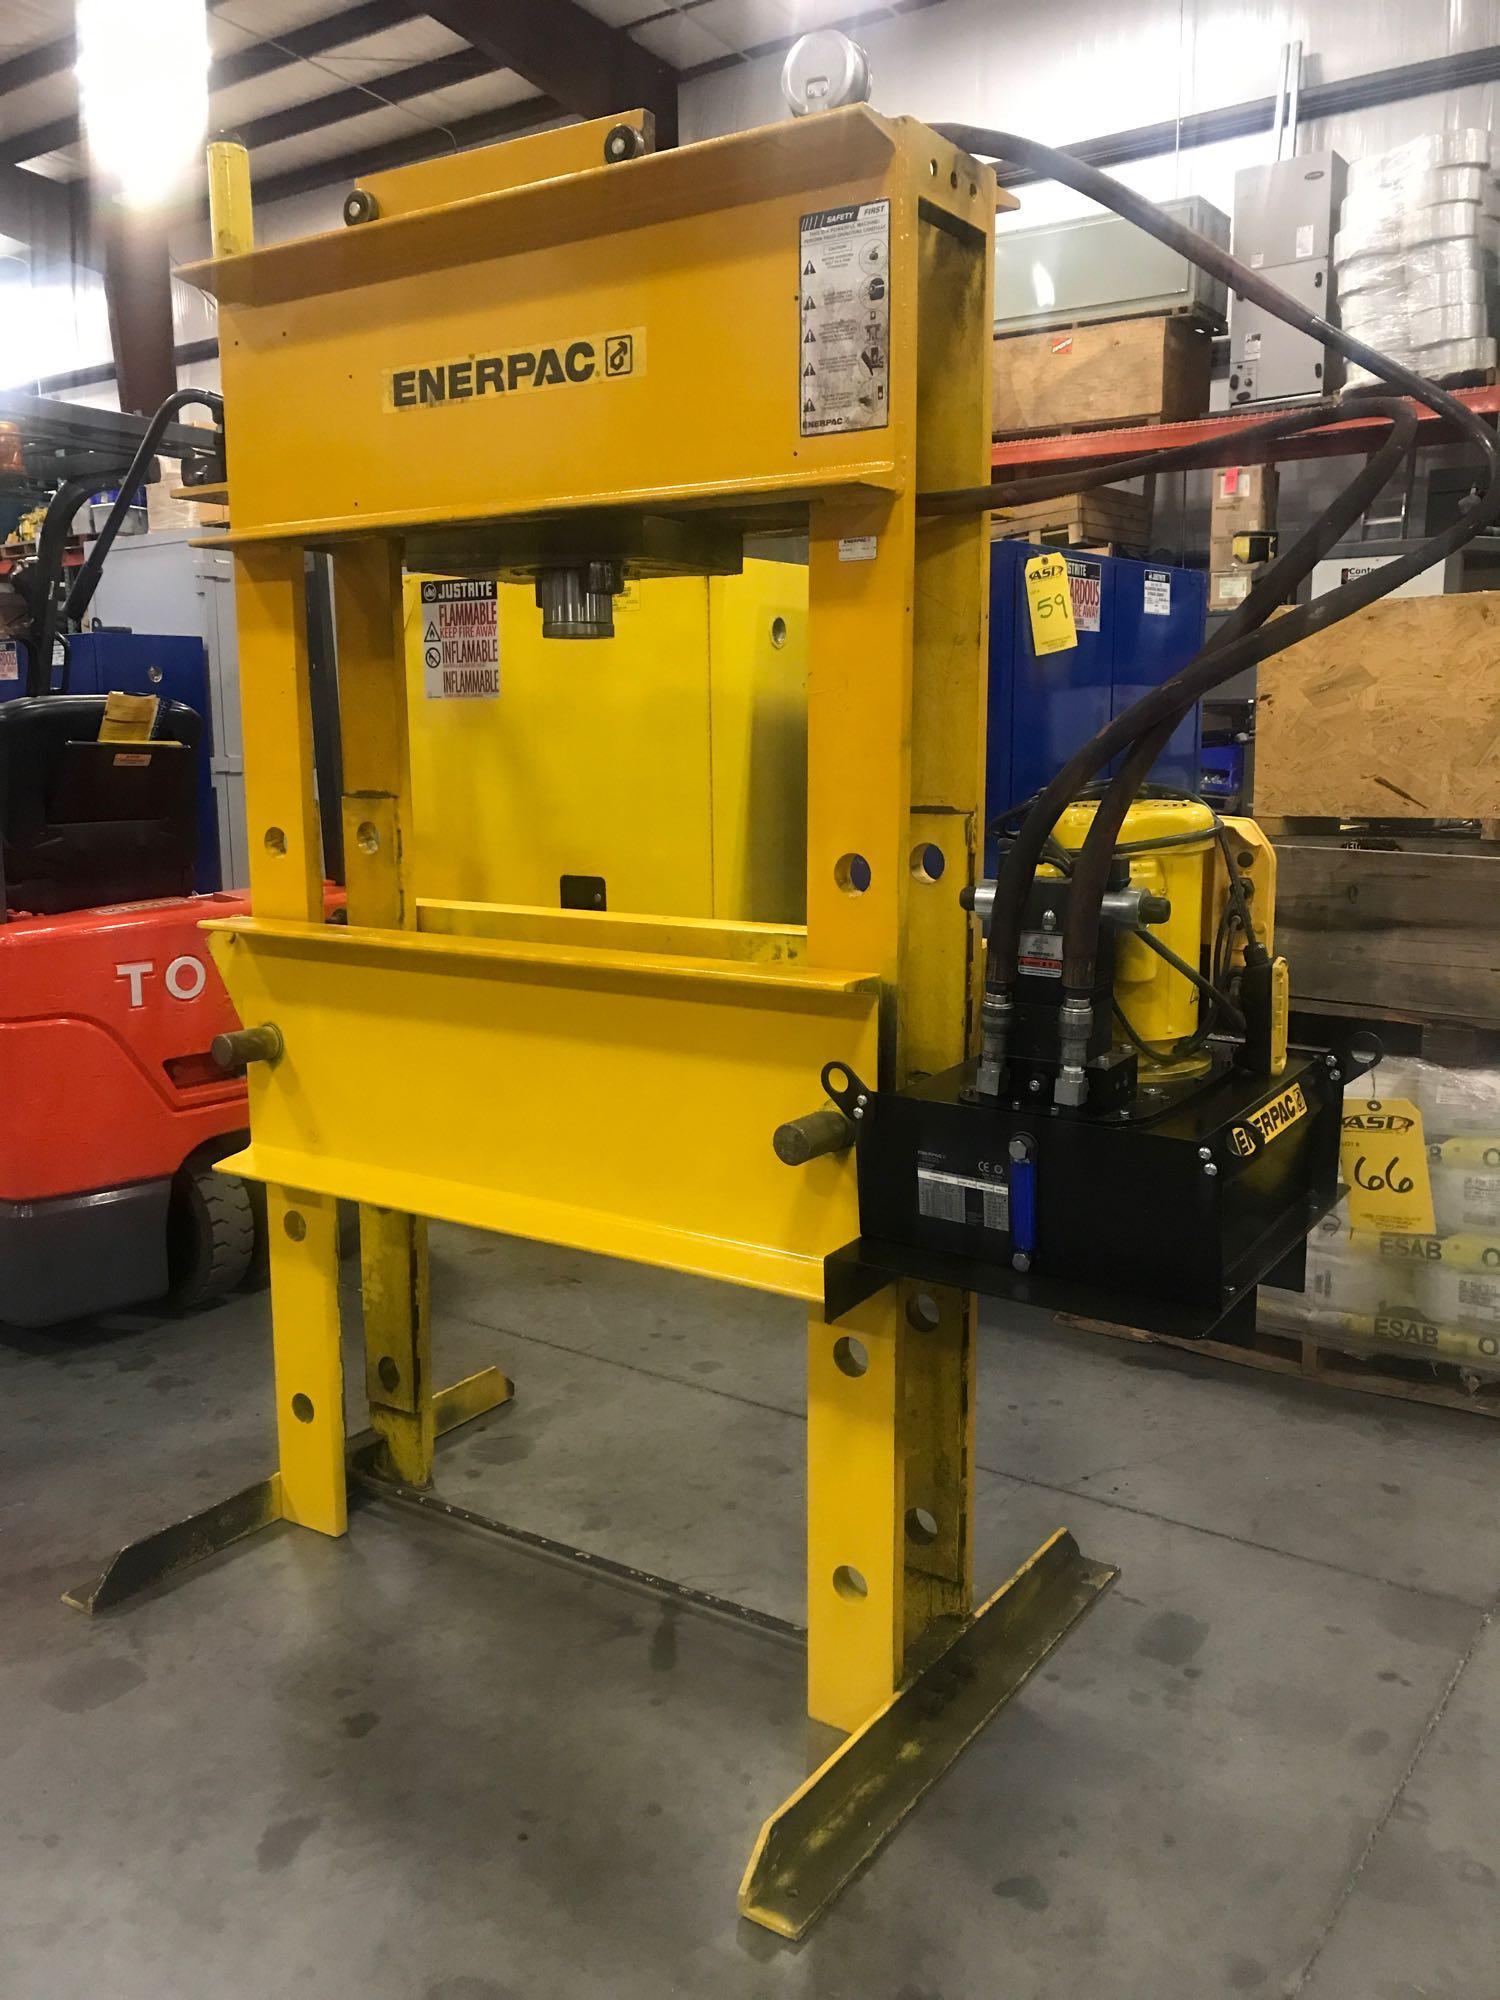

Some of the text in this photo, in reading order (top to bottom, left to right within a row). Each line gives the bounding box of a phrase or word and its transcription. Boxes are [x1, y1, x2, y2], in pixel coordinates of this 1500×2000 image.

[826, 205, 885, 224] SAFETY FIRST
[393, 342, 595, 407] ENERPAC
[802, 418, 843, 429] ENERPAC
[438, 581, 493, 599] JUSTRITE
[1069, 579, 1099, 606] ARDOUS
[438, 602, 498, 627] FLAMMABLE
[1037, 593, 1068, 619] 59
[440, 626, 497, 638] KEEP FIRE AWAY
[442, 639, 498, 664] INFLAMABLE
[443, 670, 499, 693] INFLAMMABLE
[1354, 1156, 1414, 1193] 66
[1380, 1237, 1442, 1260] ESAB
[1374, 1318, 1439, 1345] ESAB
